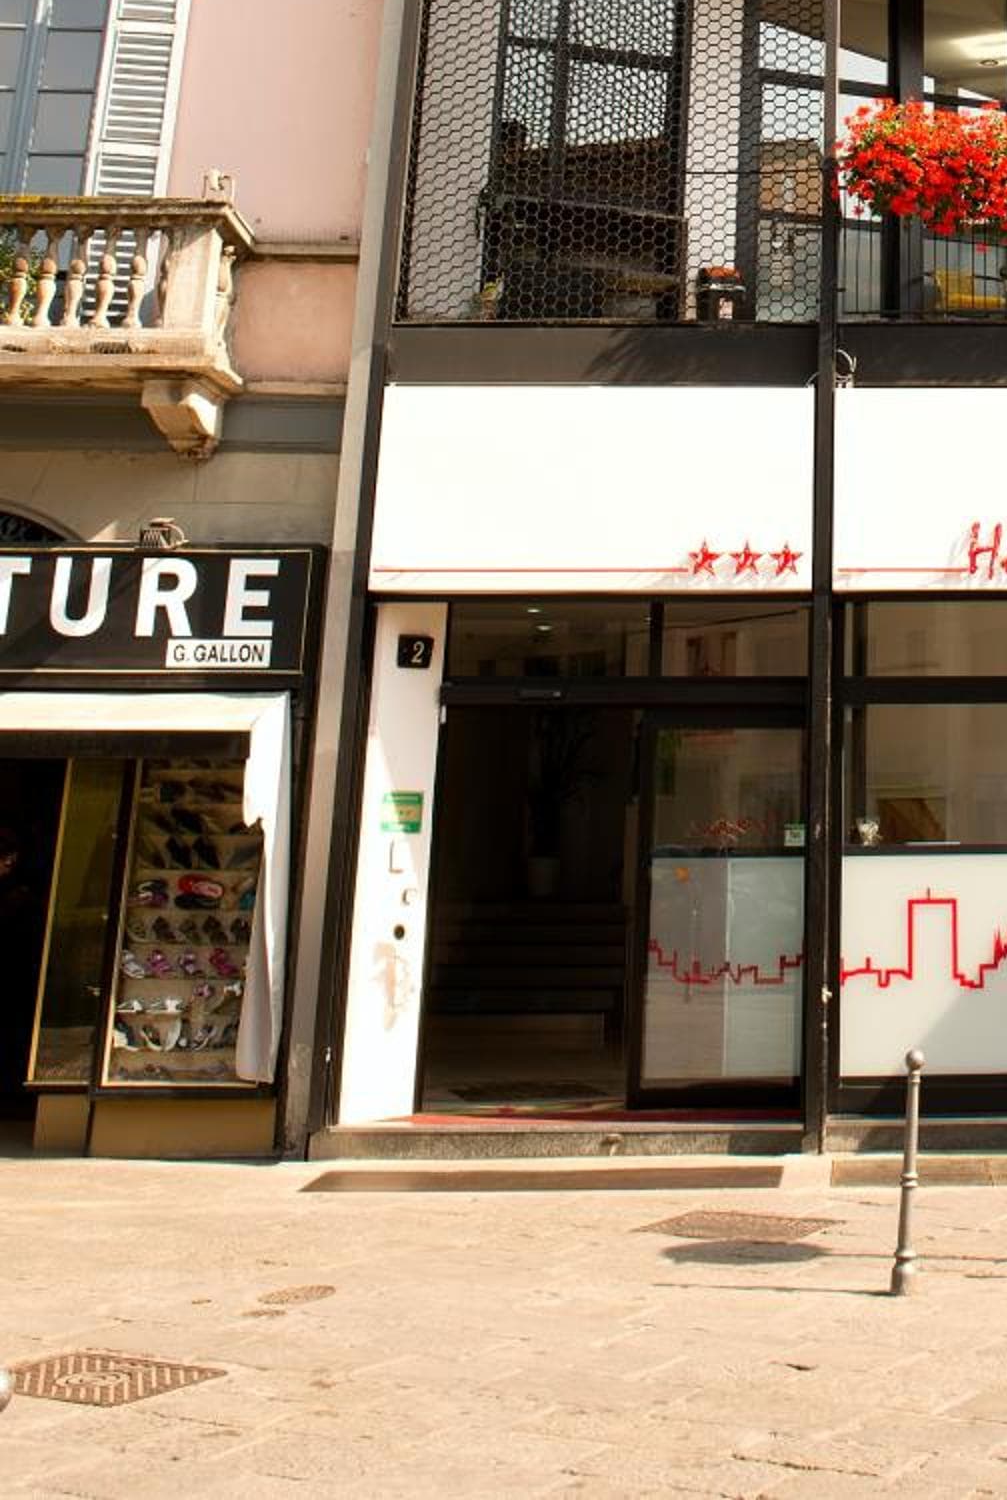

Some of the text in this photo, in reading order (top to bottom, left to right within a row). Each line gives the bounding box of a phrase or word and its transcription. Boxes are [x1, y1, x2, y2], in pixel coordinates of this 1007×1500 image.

[173, 644, 264, 663] G. GALLON
[411, 640, 425, 663] 2
